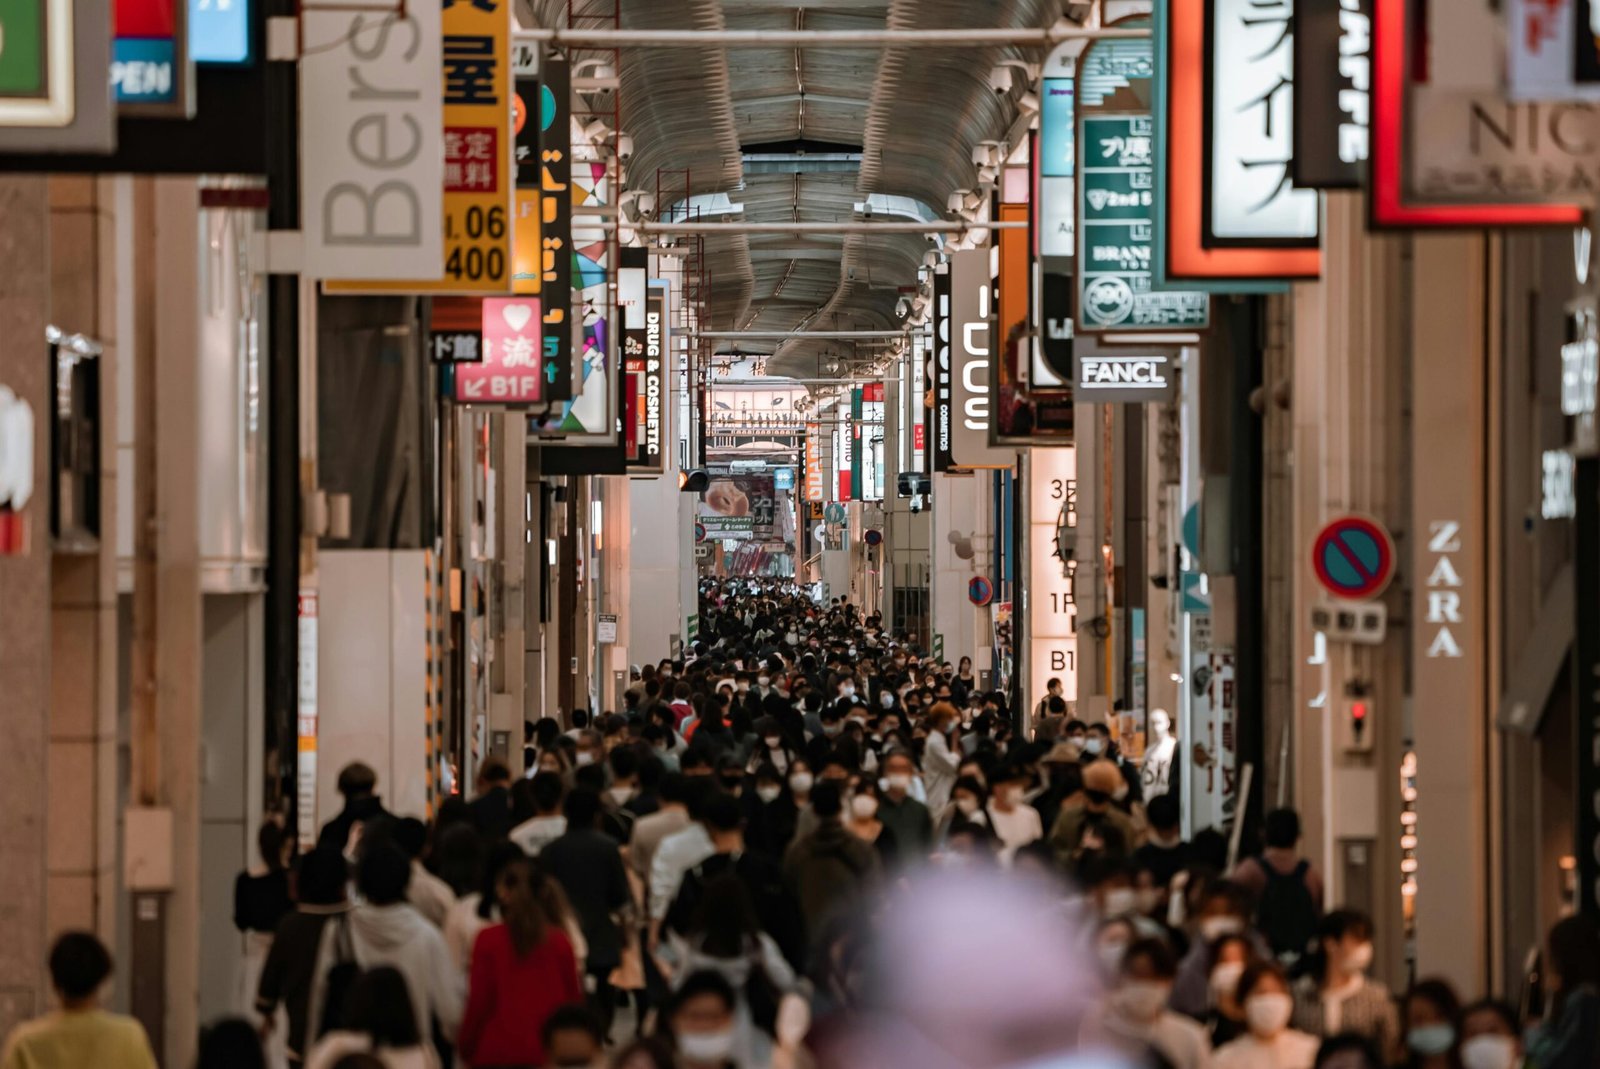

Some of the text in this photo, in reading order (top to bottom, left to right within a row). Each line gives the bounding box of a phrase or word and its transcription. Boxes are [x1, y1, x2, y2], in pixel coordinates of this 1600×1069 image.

[1338, 0, 1371, 163] AFFE
[445, 247, 504, 280] 400
[490, 376, 536, 398] B1F
[646, 312, 660, 455] DRUG & COSMETIC
[1081, 361, 1166, 383] FANCL
[940, 404, 949, 452] COSMETICS
[1050, 593, 1076, 613] 1F
[1425, 520, 1462, 658] ZARA
[1051, 651, 1074, 671] B1
